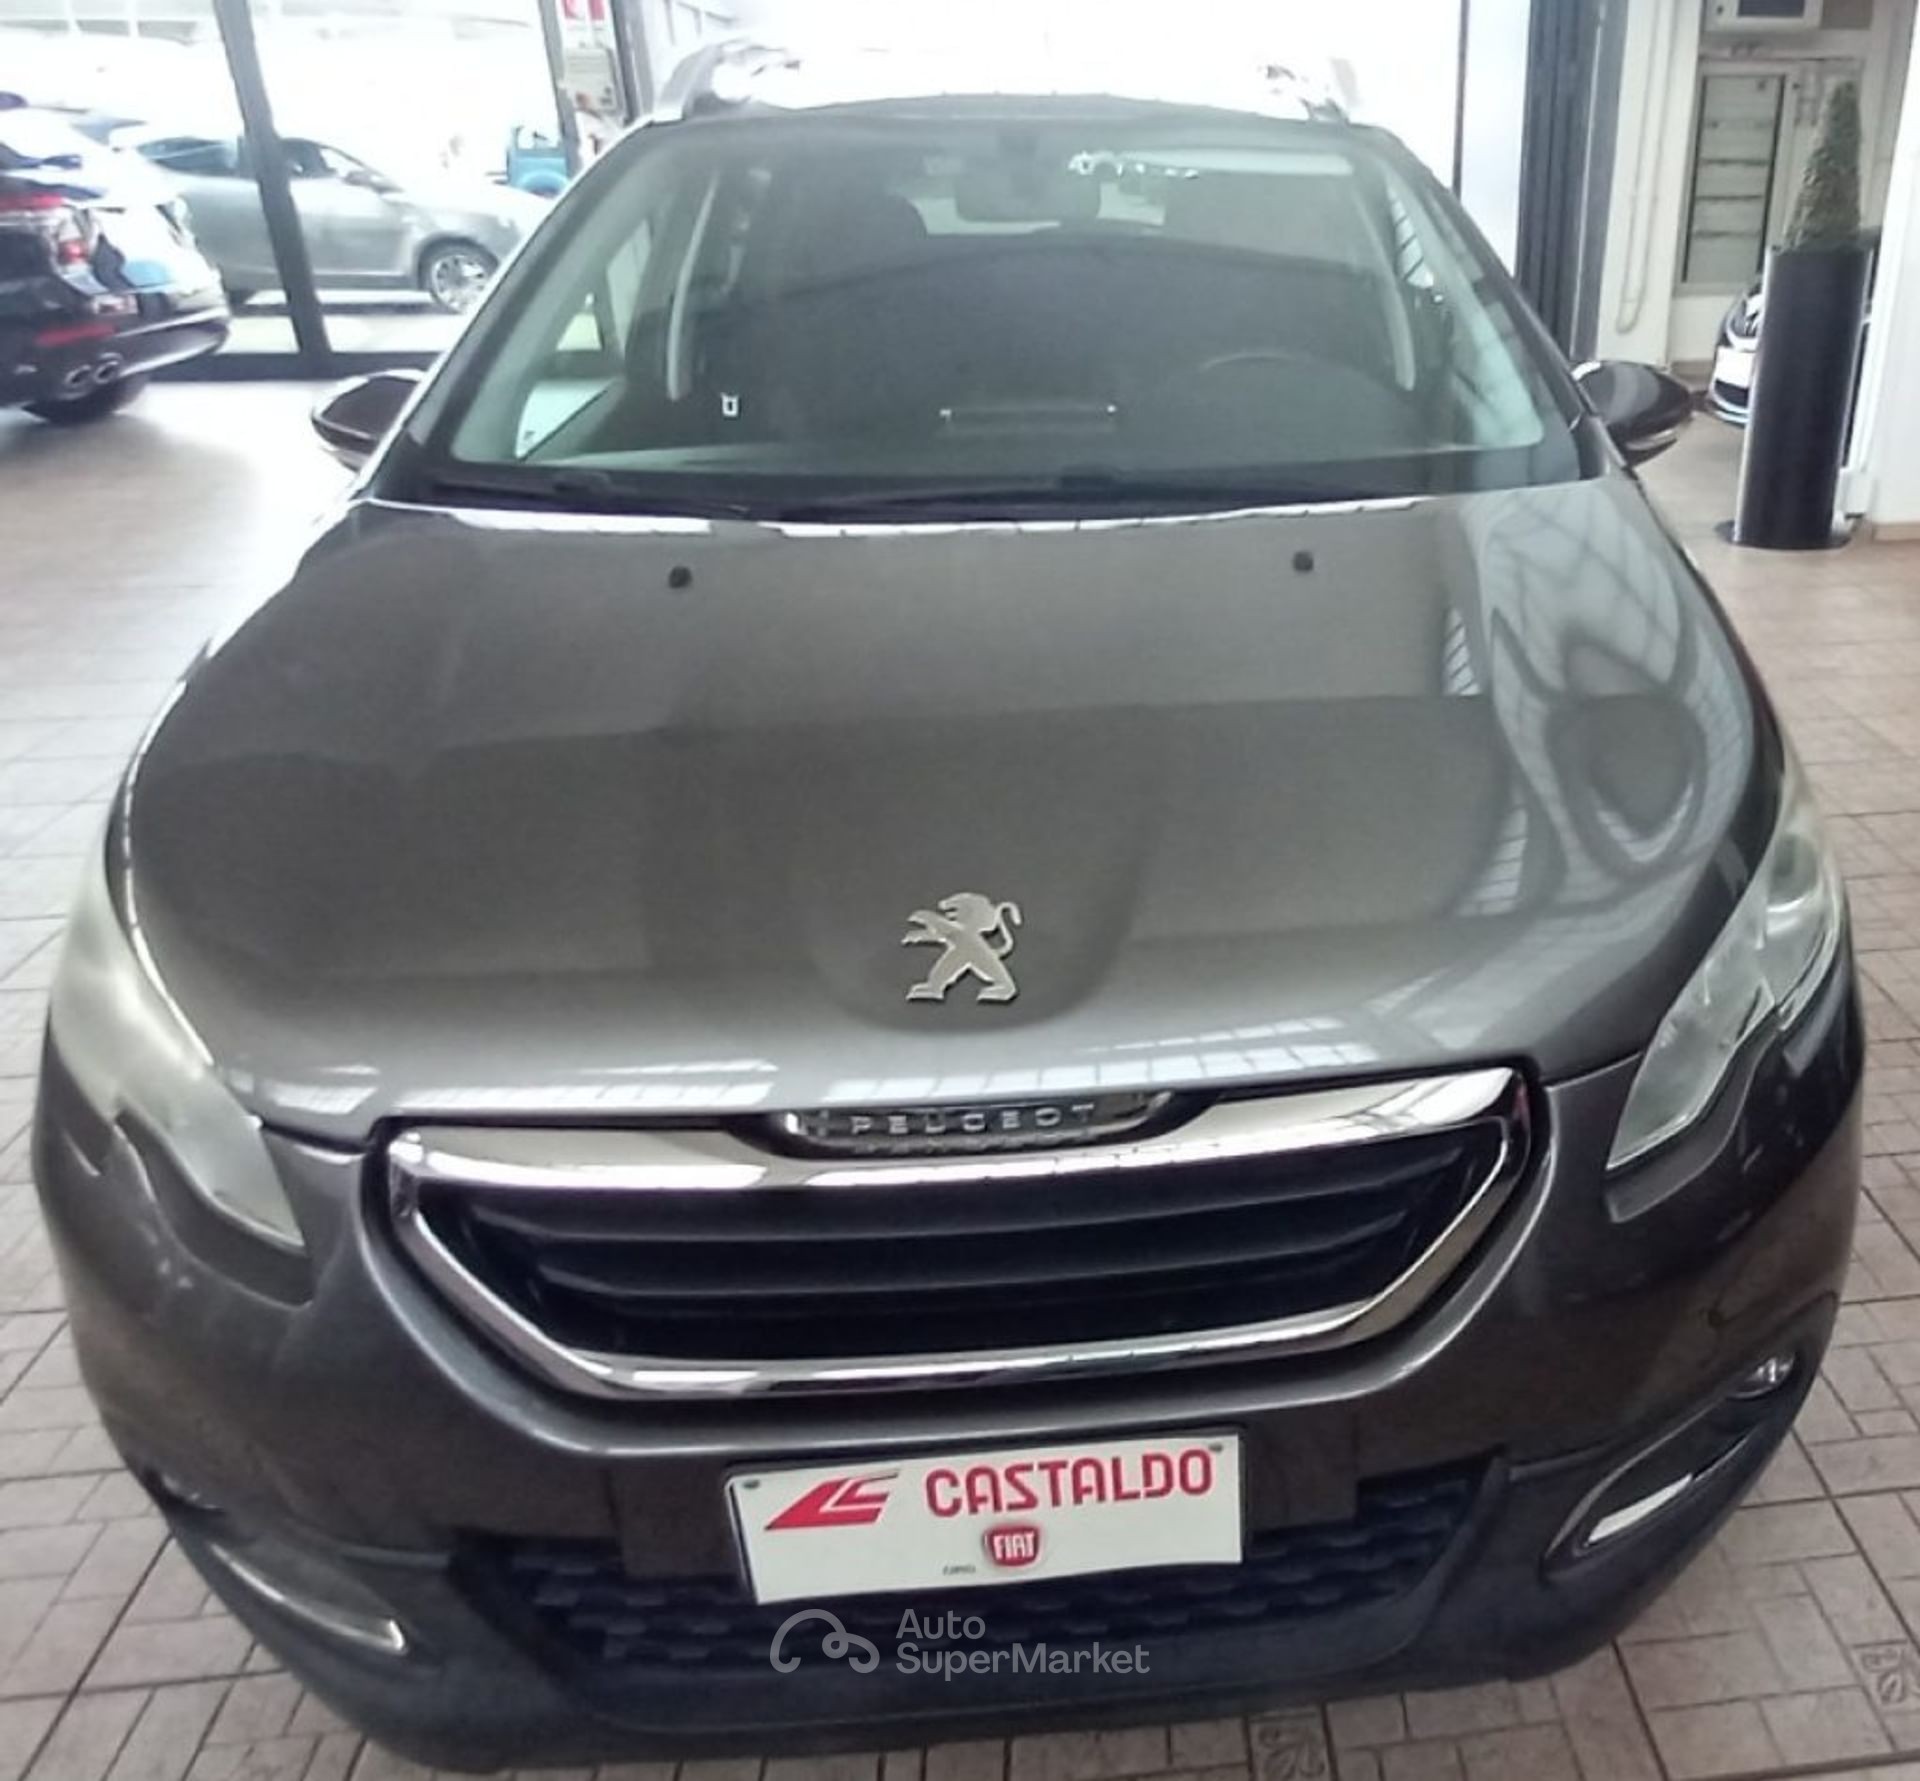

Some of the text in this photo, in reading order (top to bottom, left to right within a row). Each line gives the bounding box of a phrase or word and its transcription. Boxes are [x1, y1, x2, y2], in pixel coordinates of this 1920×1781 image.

[850, 1102, 1095, 1136] PEUGEOT
[925, 1449, 1212, 1517] CASTALDO
[993, 1531, 1034, 1559] FIAT
